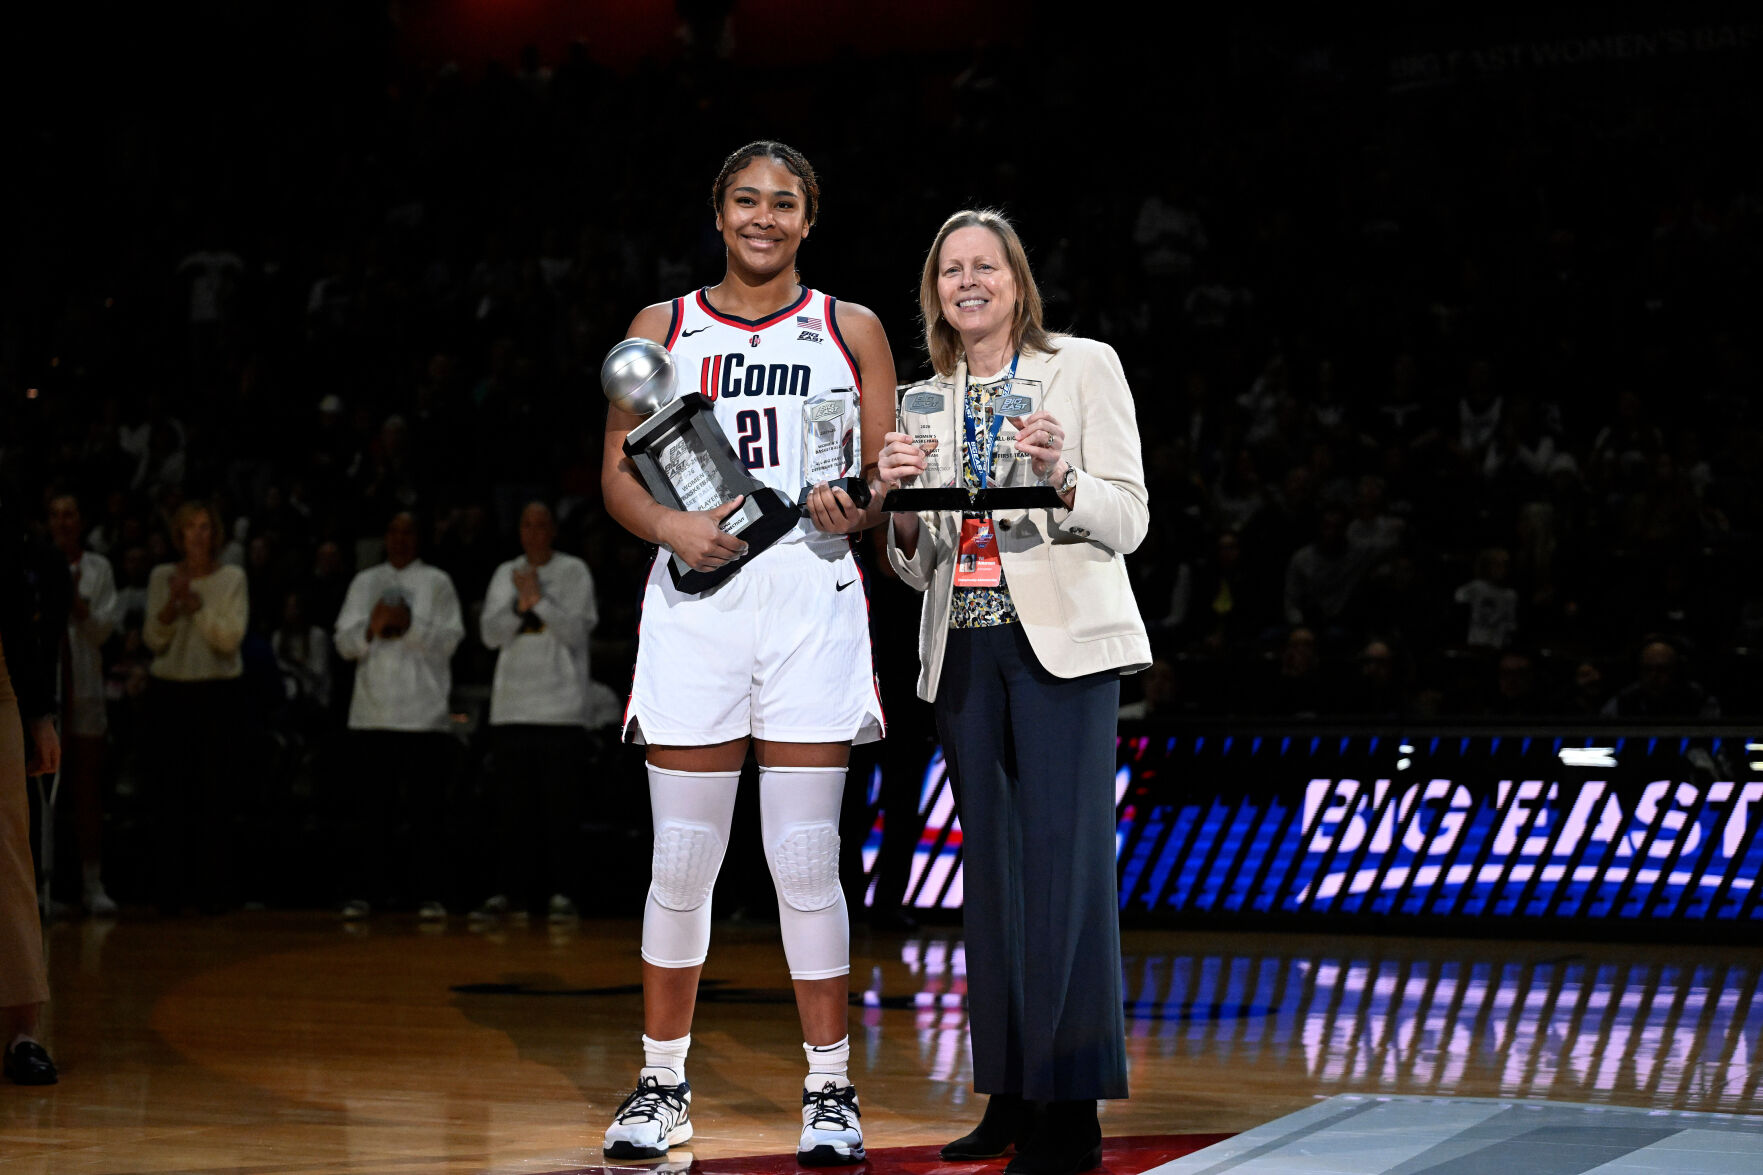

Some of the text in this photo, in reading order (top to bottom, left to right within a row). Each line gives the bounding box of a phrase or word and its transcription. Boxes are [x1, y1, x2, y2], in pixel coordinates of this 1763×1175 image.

[1530, 28, 1688, 67] WOMEN'S
[797, 335, 824, 345] EAST
[801, 330, 819, 338] BIG
[700, 352, 812, 403] UConn
[1001, 403, 1027, 411] EAST
[736, 406, 781, 470] 21
[1302, 778, 1763, 858] BIG EAST
